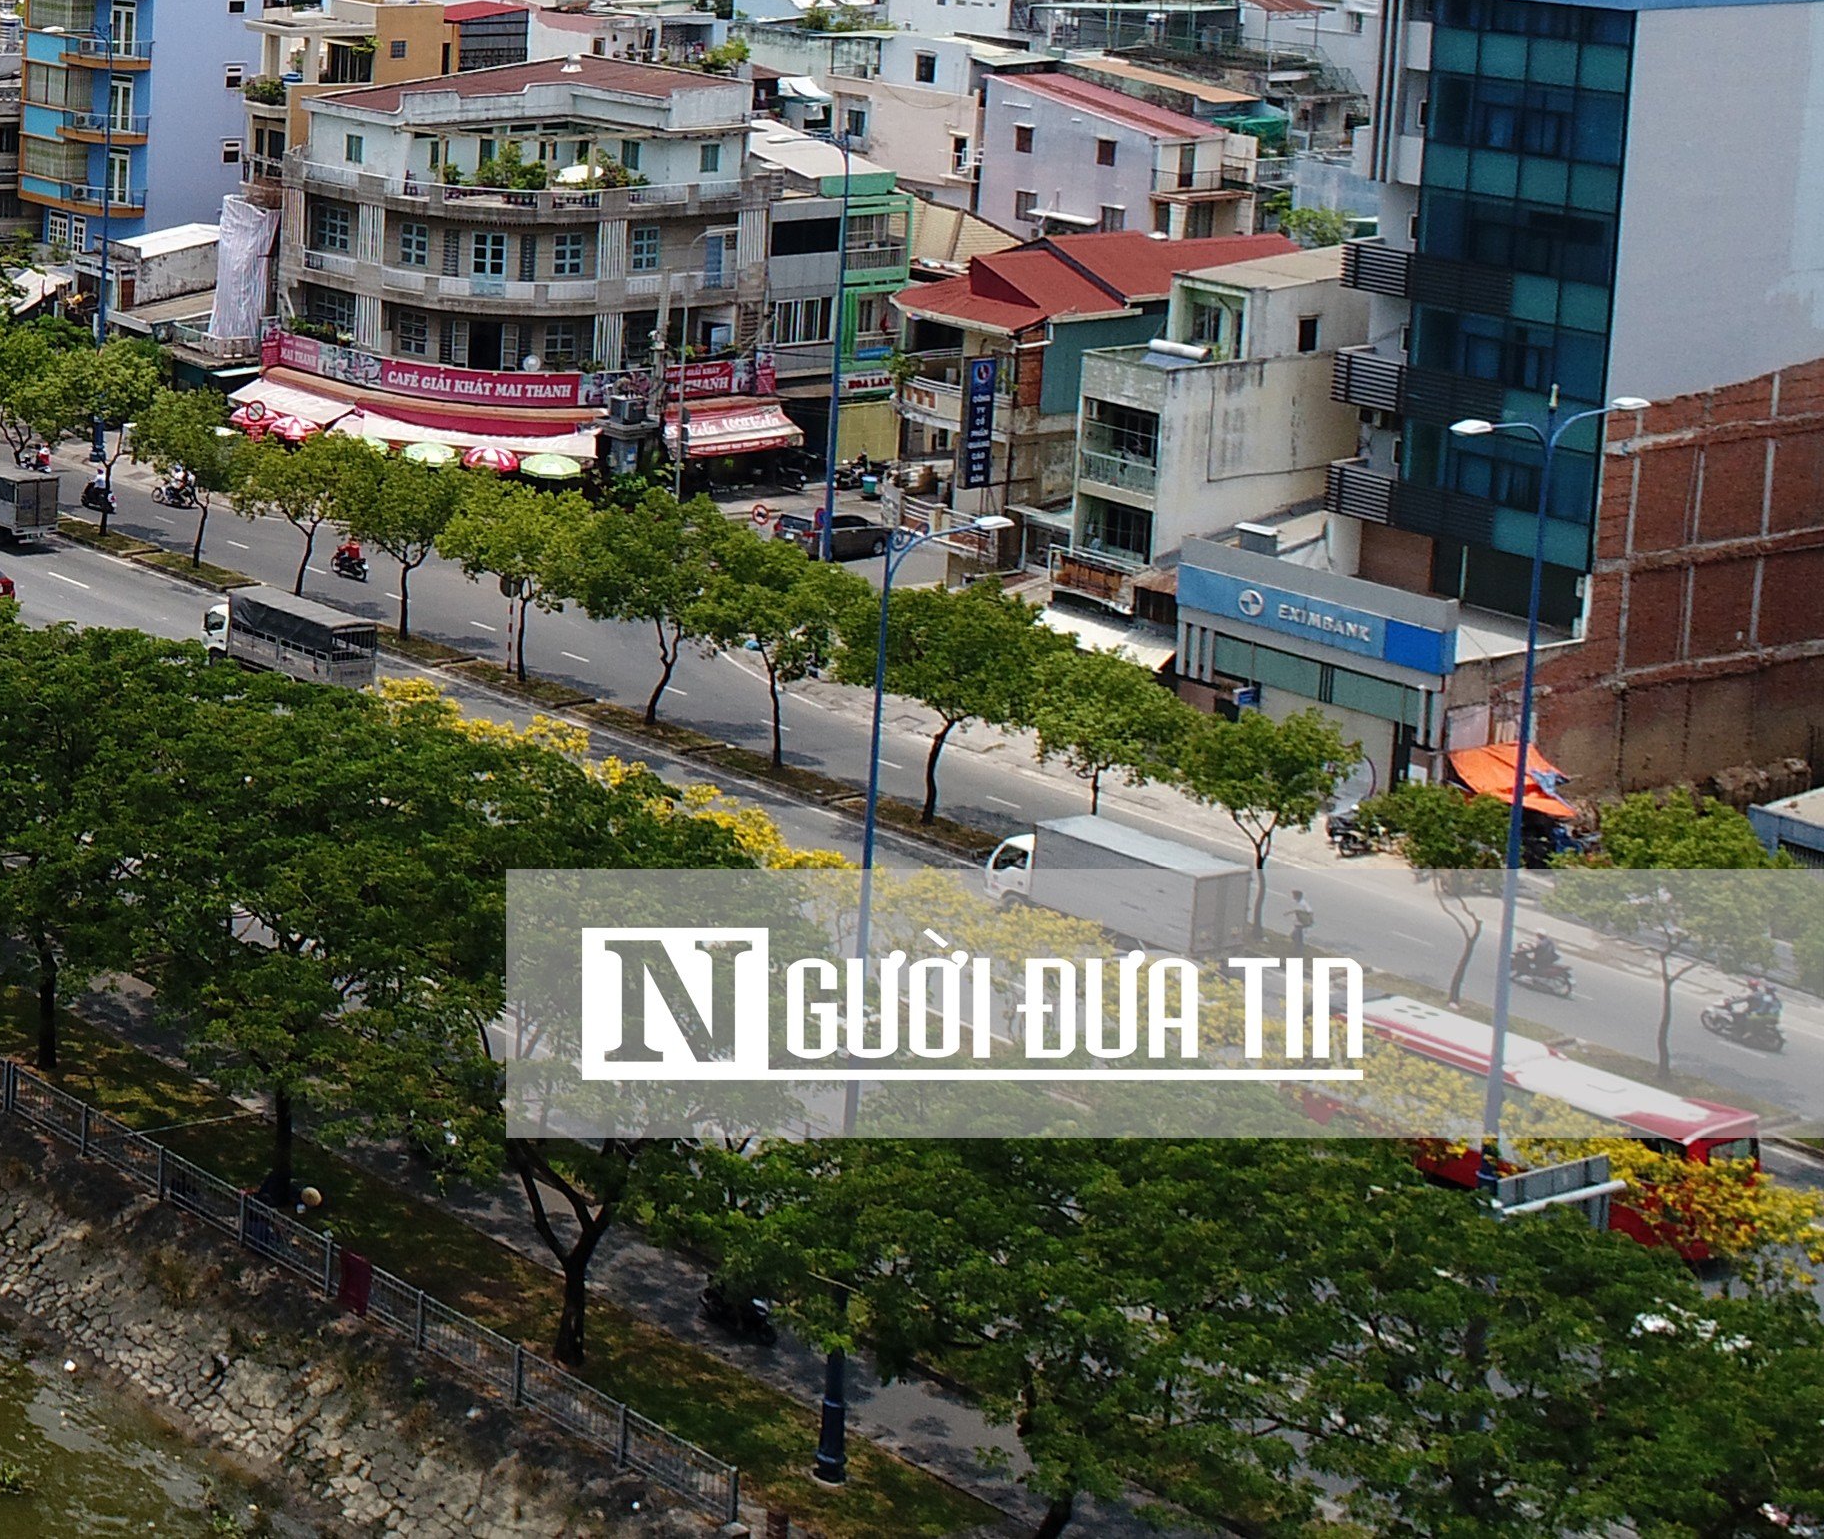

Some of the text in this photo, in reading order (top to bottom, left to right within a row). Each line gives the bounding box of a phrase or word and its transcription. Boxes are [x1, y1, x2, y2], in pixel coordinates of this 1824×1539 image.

[387, 370, 572, 399] CAFÉ GIẢI KHÁT MAI THANH
[1277, 603, 1372, 643] EXIMBANK
